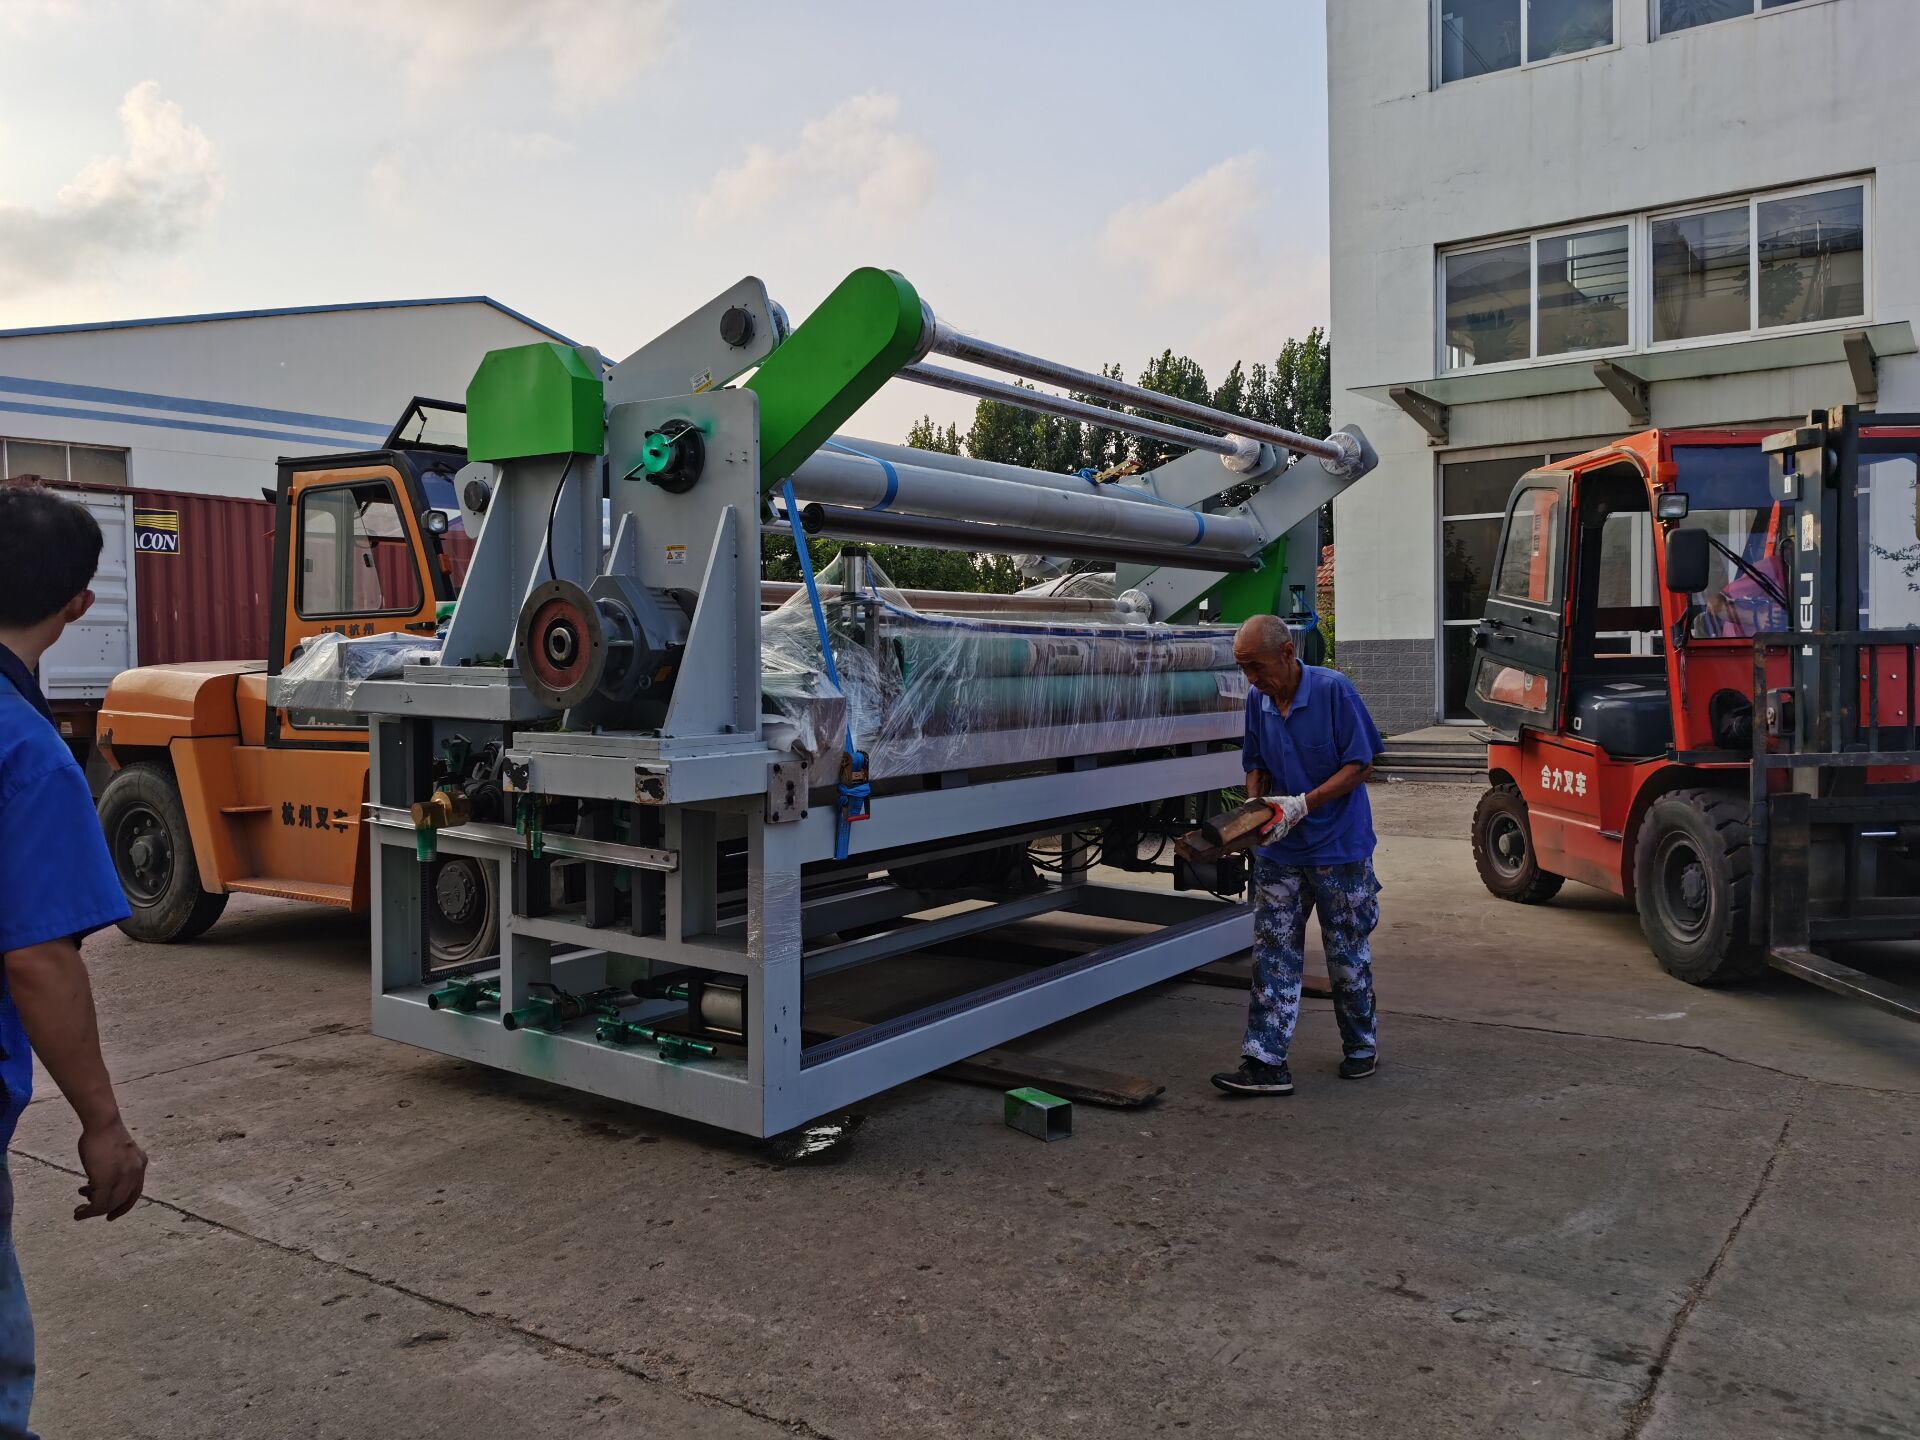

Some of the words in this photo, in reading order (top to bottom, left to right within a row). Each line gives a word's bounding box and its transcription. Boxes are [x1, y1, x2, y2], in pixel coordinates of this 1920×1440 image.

[1541, 764, 1587, 797] 合力叉车
[281, 801, 349, 834] 杭州叉车
